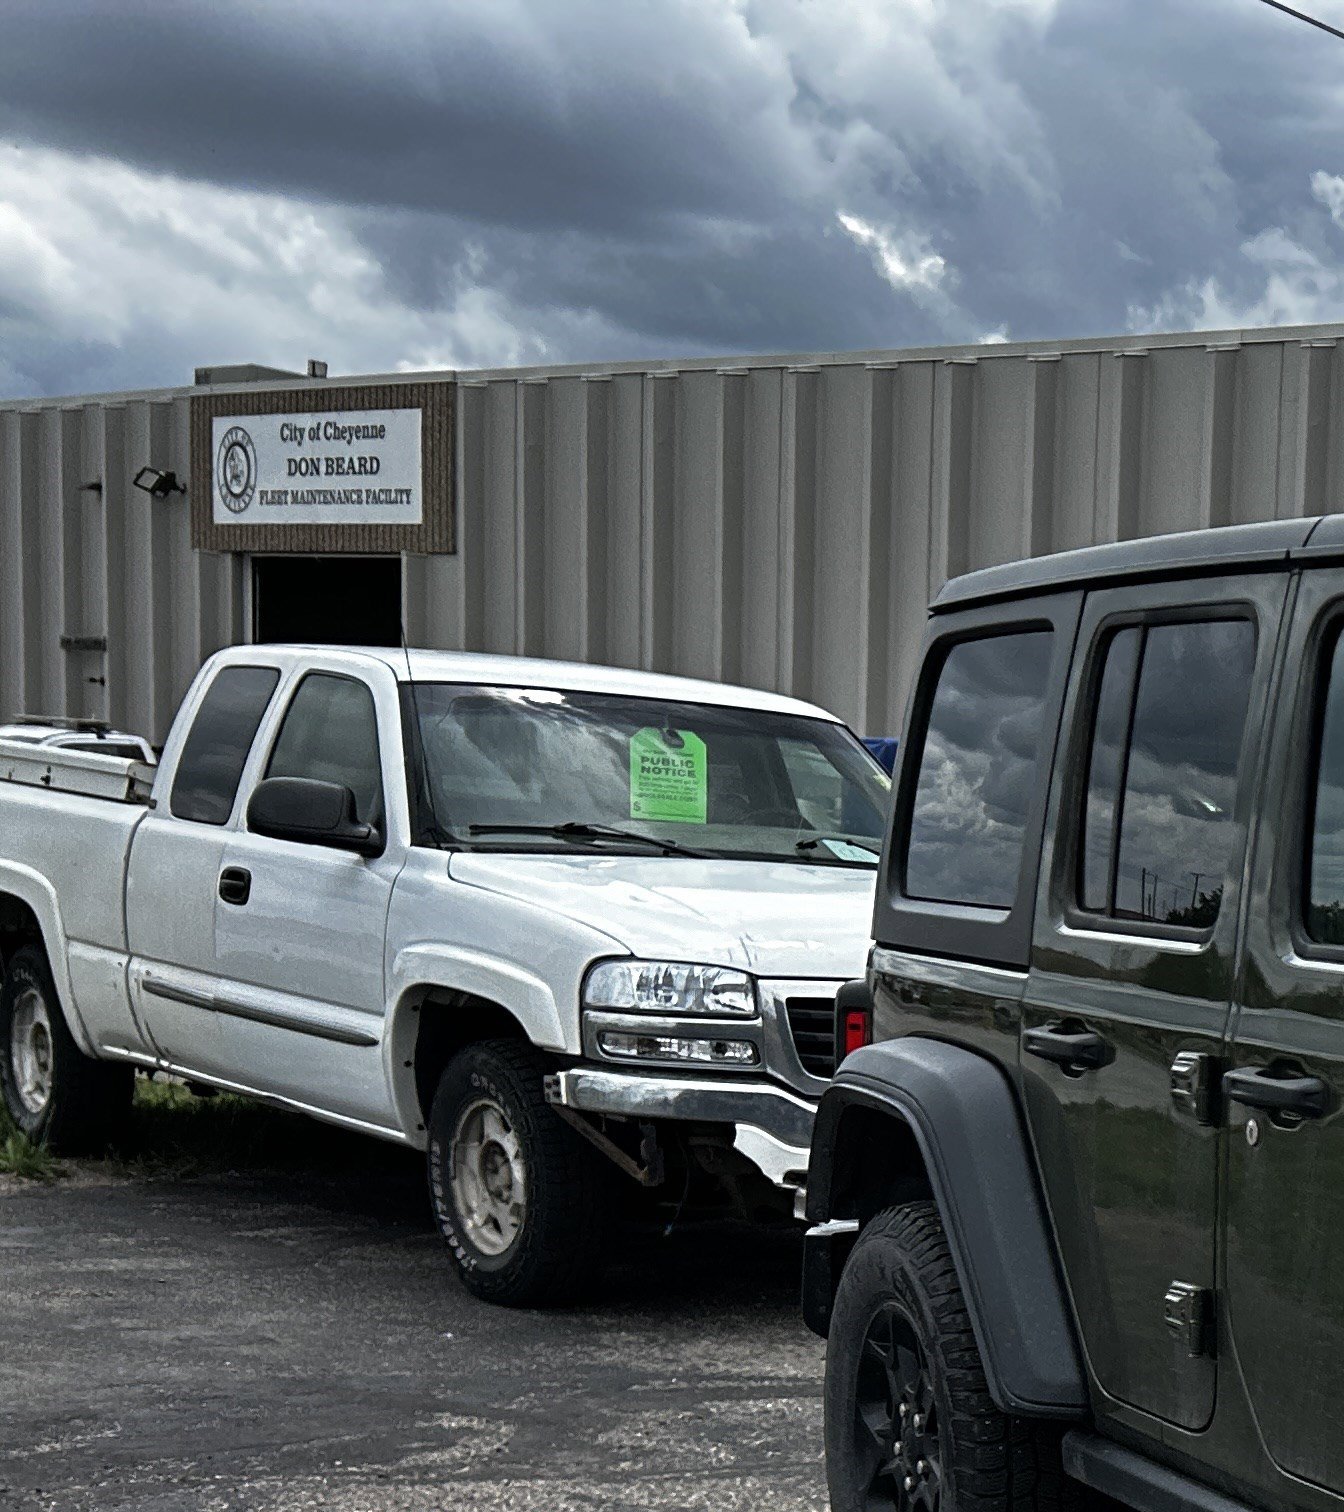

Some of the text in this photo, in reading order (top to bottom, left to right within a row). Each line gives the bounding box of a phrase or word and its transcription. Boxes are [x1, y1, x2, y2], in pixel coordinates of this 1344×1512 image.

[280, 421, 386, 445] City of Cheyenne
[287, 455, 381, 477] DON BEARD
[258, 489, 289, 506] FLEET
[290, 488, 363, 505] MAINTENANCE
[365, 488, 413, 505] FACILITY
[641, 756, 694, 768] PUBLIC
[641, 766, 697, 778] NOTICE
